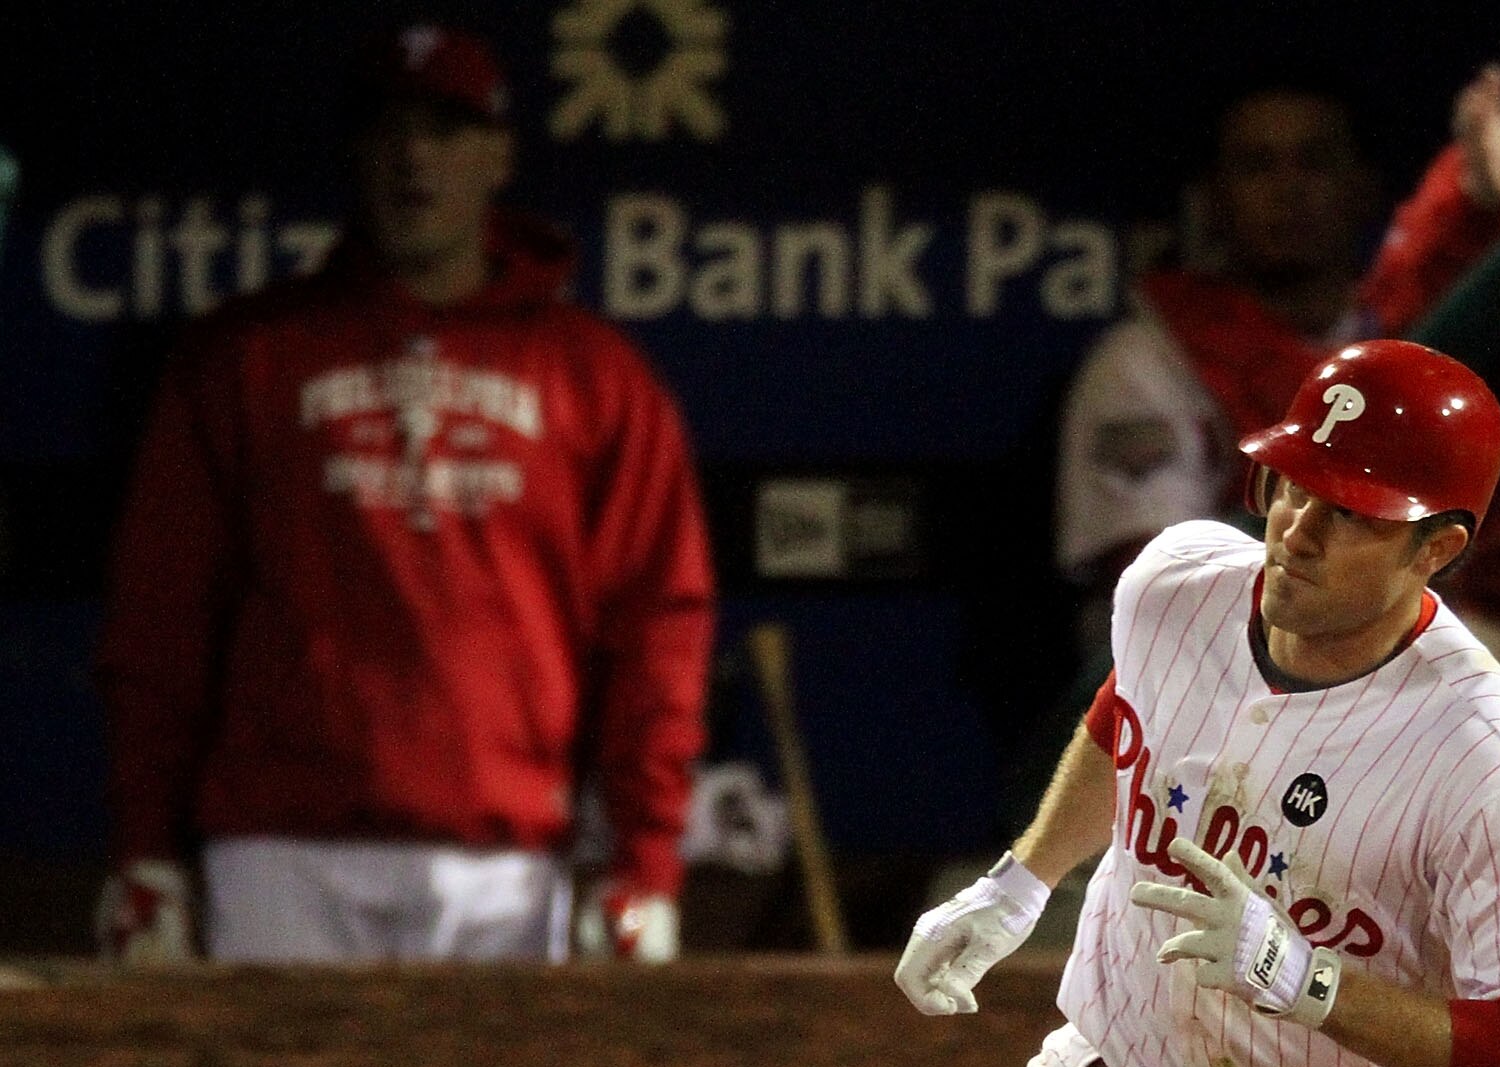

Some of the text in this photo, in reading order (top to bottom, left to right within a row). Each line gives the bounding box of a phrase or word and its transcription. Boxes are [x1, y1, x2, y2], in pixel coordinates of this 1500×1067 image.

[42, 195, 341, 320] Citiz
[605, 187, 936, 320] Bank
[1312, 384, 1366, 443] P
[1286, 783, 1323, 818] HK
